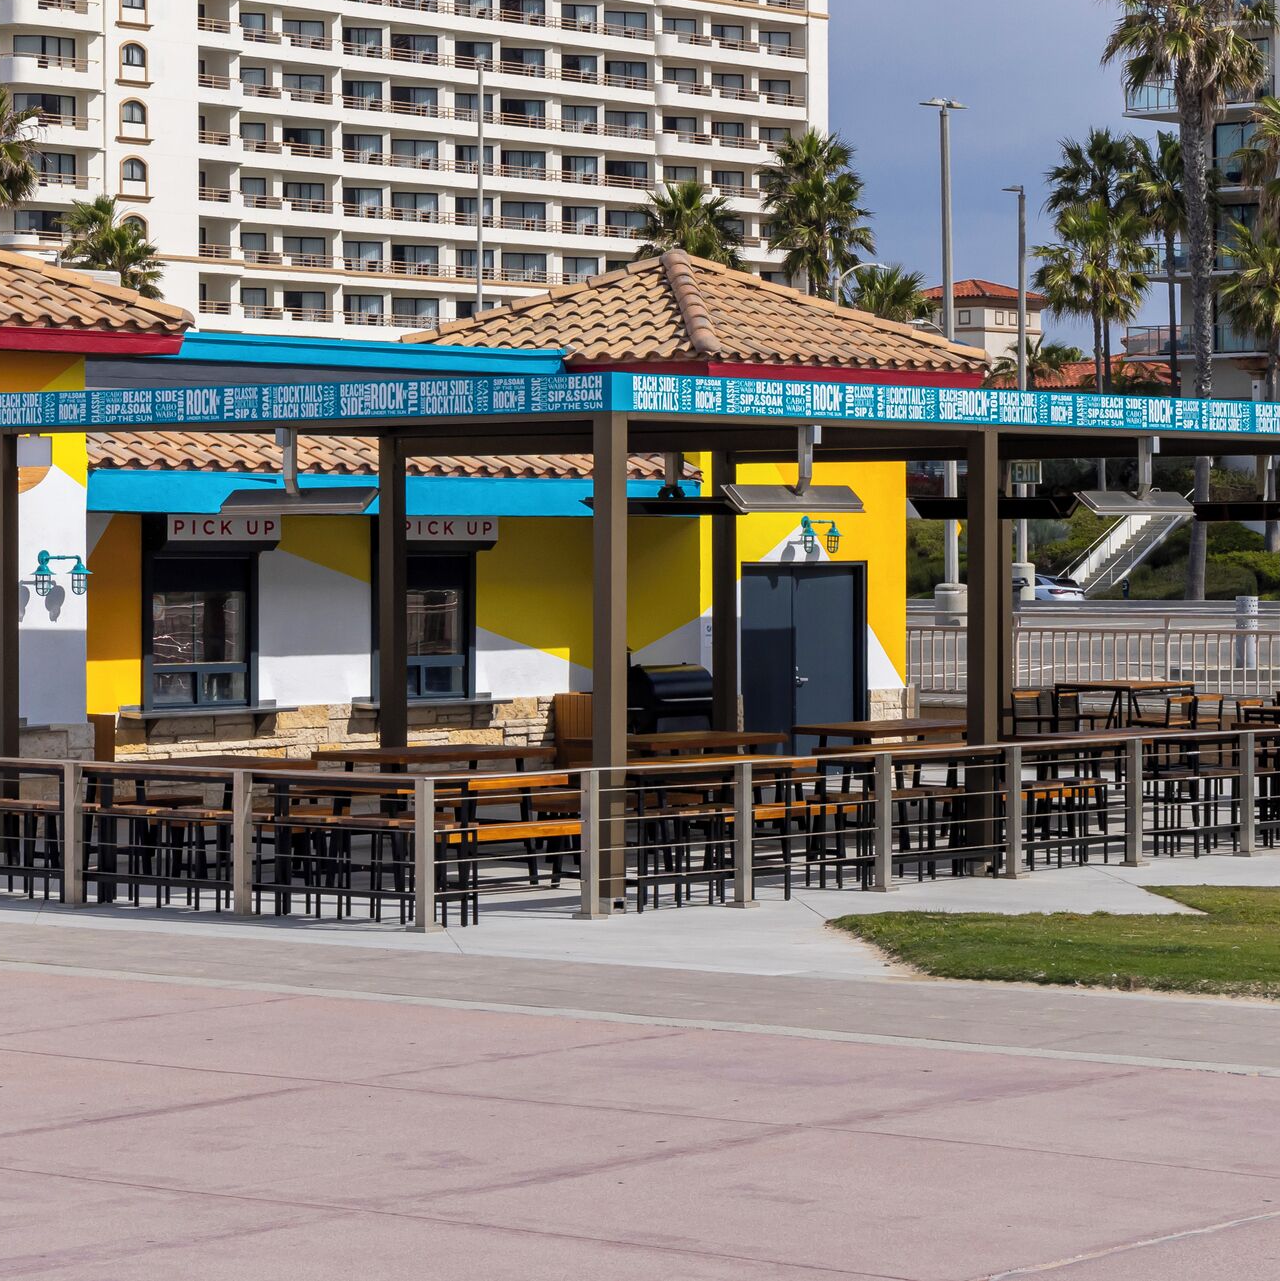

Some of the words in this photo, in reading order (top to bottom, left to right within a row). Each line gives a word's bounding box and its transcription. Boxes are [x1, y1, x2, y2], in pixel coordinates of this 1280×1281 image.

[421, 381, 448, 396] BEACH
[450, 380, 469, 396] SIDE
[568, 376, 602, 389] BEACH
[633, 376, 657, 391] BEACH
[659, 377, 675, 391] SIDE
[756, 382, 782, 394] BEACH
[786, 384, 805, 396] SIDE
[123, 391, 152, 403] BEACH
[155, 390, 177, 402] SIDE
[235, 388, 258, 399] CLASSIC
[278, 385, 322, 403] COCKTAILS
[340, 384, 364, 397] BEACH
[371, 383, 403, 409] ROCK
[408, 382, 418, 414] ROLL
[531, 378, 540, 411] CLASSIC
[548, 390, 602, 402] SIP&SOAK
[727, 380, 735, 413] CLASSIC
[813, 384, 840, 411] ROCK
[855, 386, 874, 398] CLASSIC
[890, 388, 926, 405] COCKTAILS
[939, 390, 957, 401] BEACH
[22, 394, 38, 407] SIDE
[186, 389, 217, 415] ROCK
[224, 388, 234, 419] ROLL
[426, 395, 473, 414] COCKTAILS
[493, 391, 515, 408] ROCK
[638, 392, 679, 410] COCKTAILS
[695, 391, 714, 408] ROCK
[741, 394, 783, 406] SIP&SOAK
[846, 386, 854, 416] ROLL
[963, 391, 987, 416] ROCK
[999, 392, 1019, 406] BEACH
[1021, 393, 1035, 406] SIDE
[1101, 397, 1123, 408] BEACH
[1126, 398, 1142, 409] SIDE
[59, 404, 78, 420] ROCK
[92, 392, 100, 422] CLASSIC
[106, 404, 152, 414] SIP&SOAK
[235, 409, 249, 419] SIP
[251, 409, 258, 418] &
[273, 404, 298, 418] BEACH
[301, 403, 318, 417] SIDE
[341, 398, 364, 416] SIDE
[855, 407, 867, 417] SIP
[868, 408, 874, 417] &
[886, 405, 907, 419] BEACH
[908, 406, 923, 419] SIDE
[940, 401, 957, 419] SIDE
[1003, 406, 1037, 423] COCKTAILS
[1088, 409, 1123, 419] SIP&SOAK
[1148, 400, 1171, 423] ROCK
[1212, 403, 1242, 418] COCKTAILS
[2, 407, 42, 424] COCKTAILS
[1183, 420, 1193, 429] SIP
[1210, 418, 1226, 430] BEACH
[1016, 463, 1036, 481] EXIT
[173, 520, 232, 535] PICK
[247, 520, 275, 535] UP
[467, 521, 493, 535] UP
